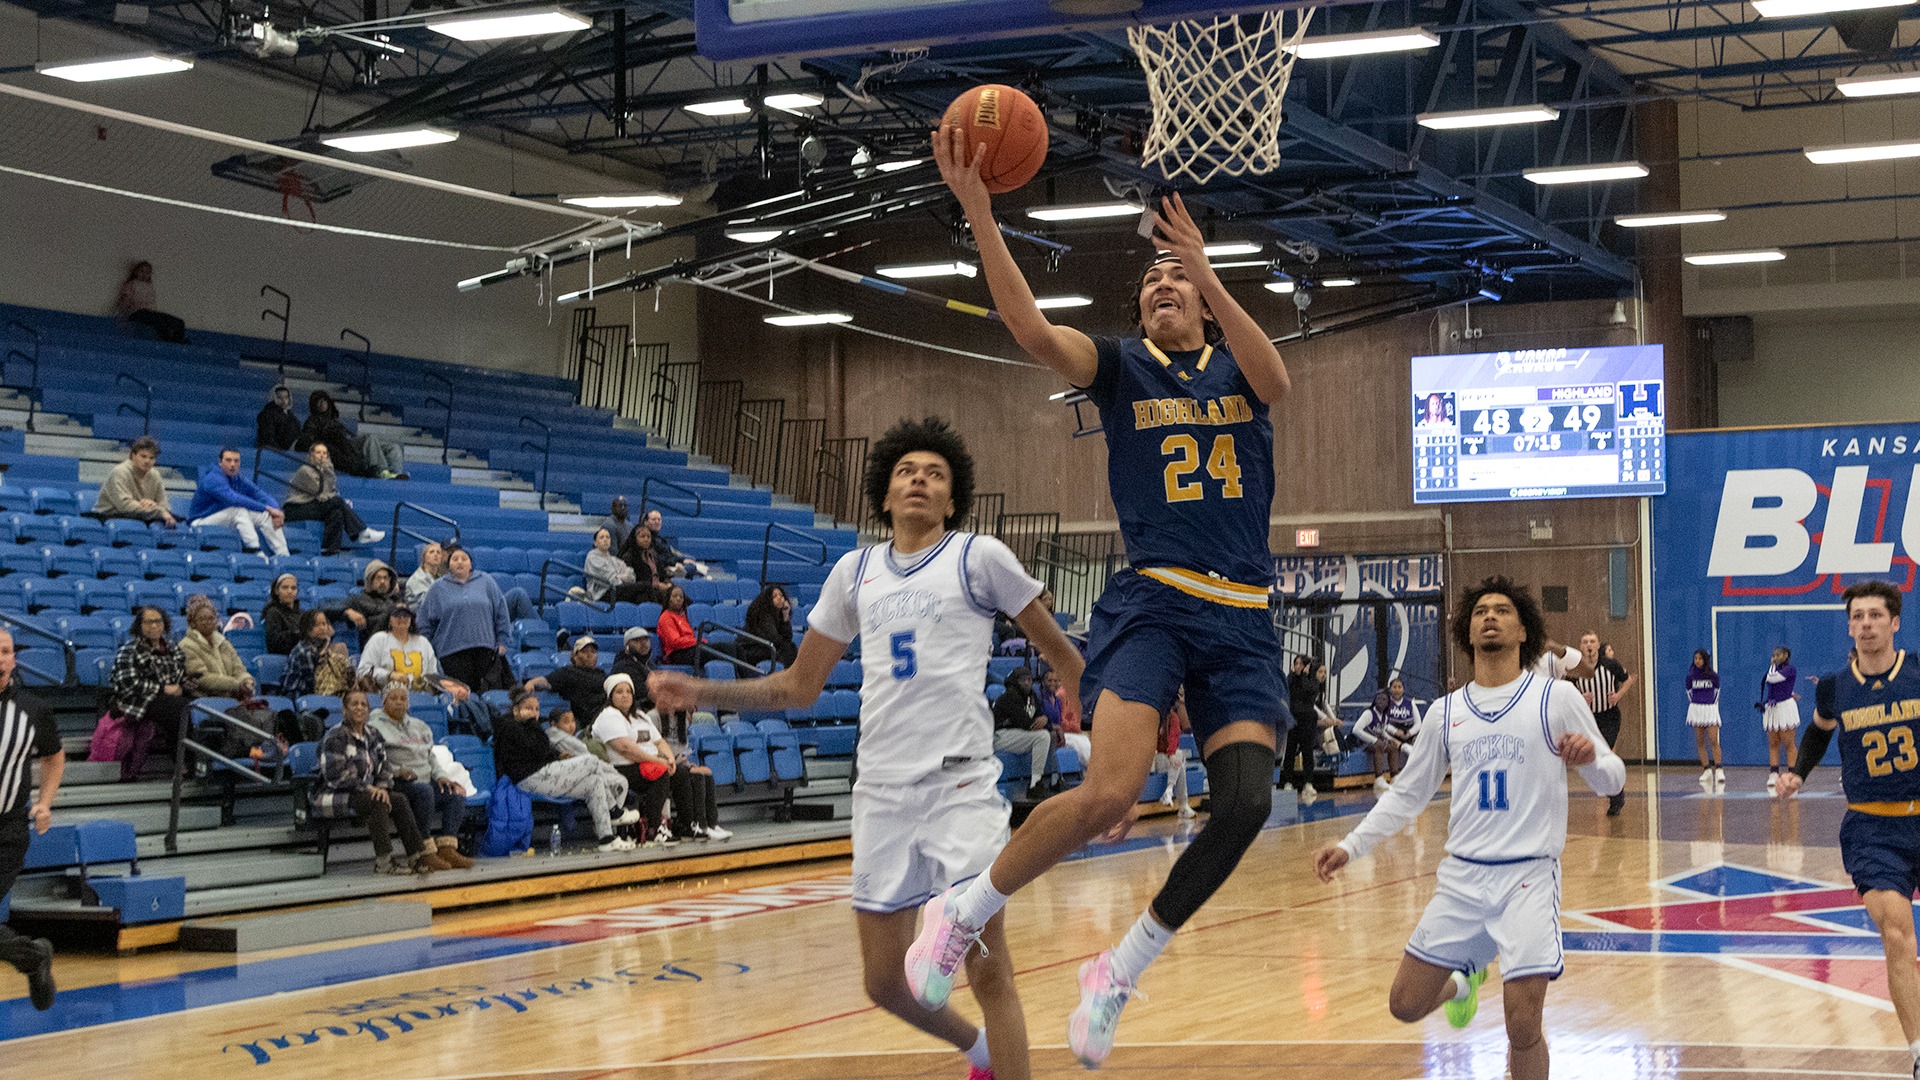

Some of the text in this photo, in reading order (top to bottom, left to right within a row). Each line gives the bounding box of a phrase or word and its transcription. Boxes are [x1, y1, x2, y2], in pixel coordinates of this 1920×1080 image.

[1551, 385, 1614, 401] HIGHLAND
[1132, 395, 1254, 430] HIGHLAND
[1473, 408, 1511, 435] 48
[1563, 404, 1602, 432] 49
[1513, 433, 1562, 452] 07:15
[1160, 433, 1243, 503] 24
[1299, 530, 1317, 545] EXIT
[1706, 464, 1920, 577] BL
[390, 650, 423, 690] H
[890, 627, 917, 681] 5
[1462, 733, 1525, 771] KCKCC
[1861, 725, 1919, 777] 23
[1477, 769, 1510, 812] 11
